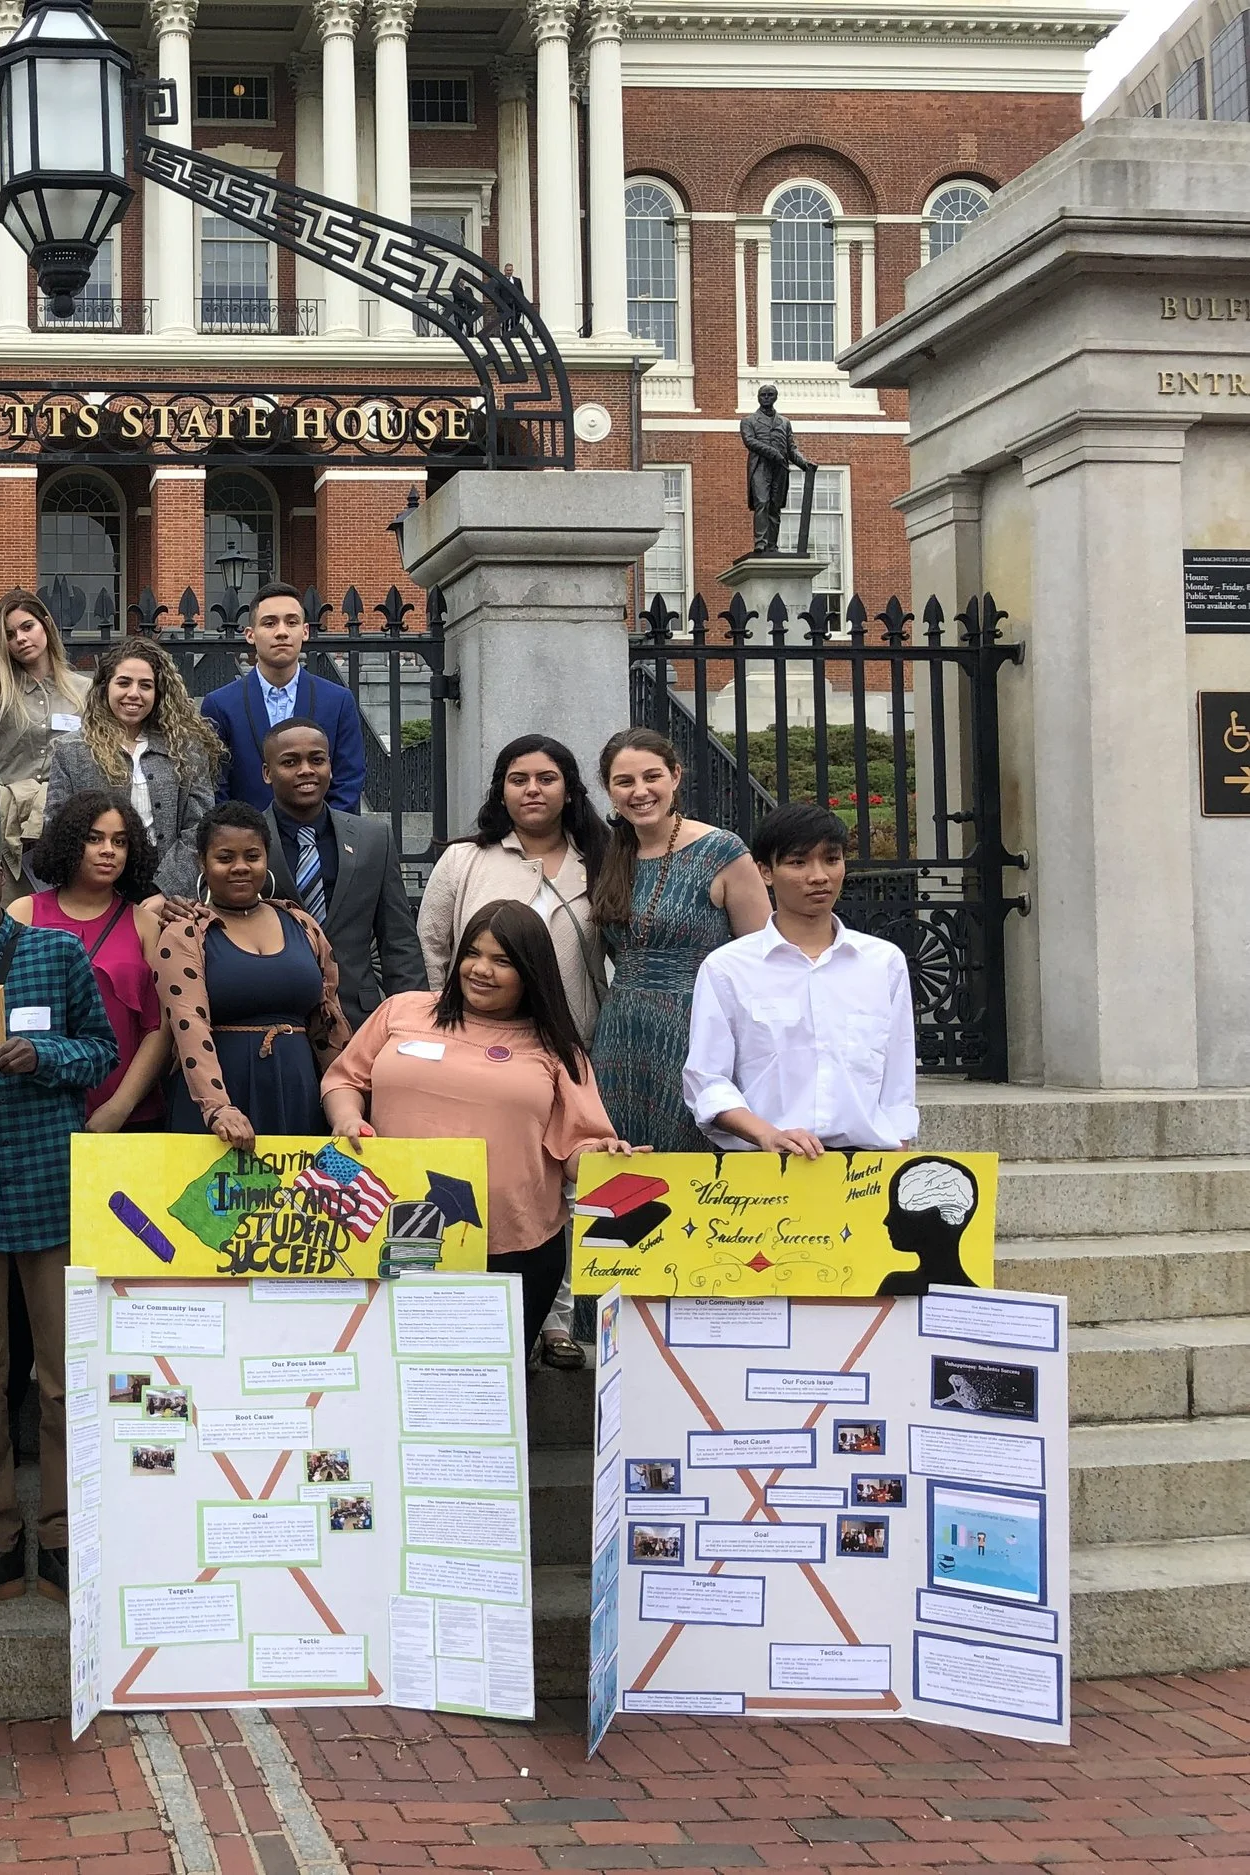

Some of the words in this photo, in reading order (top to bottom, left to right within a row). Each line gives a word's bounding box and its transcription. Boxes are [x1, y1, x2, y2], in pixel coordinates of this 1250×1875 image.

[120, 403, 272, 441] STATE
[293, 404, 471, 441] HOUSE
[1185, 573, 1209, 581] Hours:
[1185, 583, 1214, 592] Monday
[1185, 592, 1207, 600] Public
[1186, 602, 1205, 610] Tours
[1206, 601, 1236, 610] available
[843, 1159, 882, 1185] Mental
[845, 1181, 882, 1203] Health
[706, 1217, 769, 1249] Student
[772, 1216, 833, 1250] Success
[581, 1257, 642, 1278] Academic
[708, 1299, 746, 1307] Community
[146, 1304, 187, 1313] Community
[691, 1580, 716, 1588] Targets
